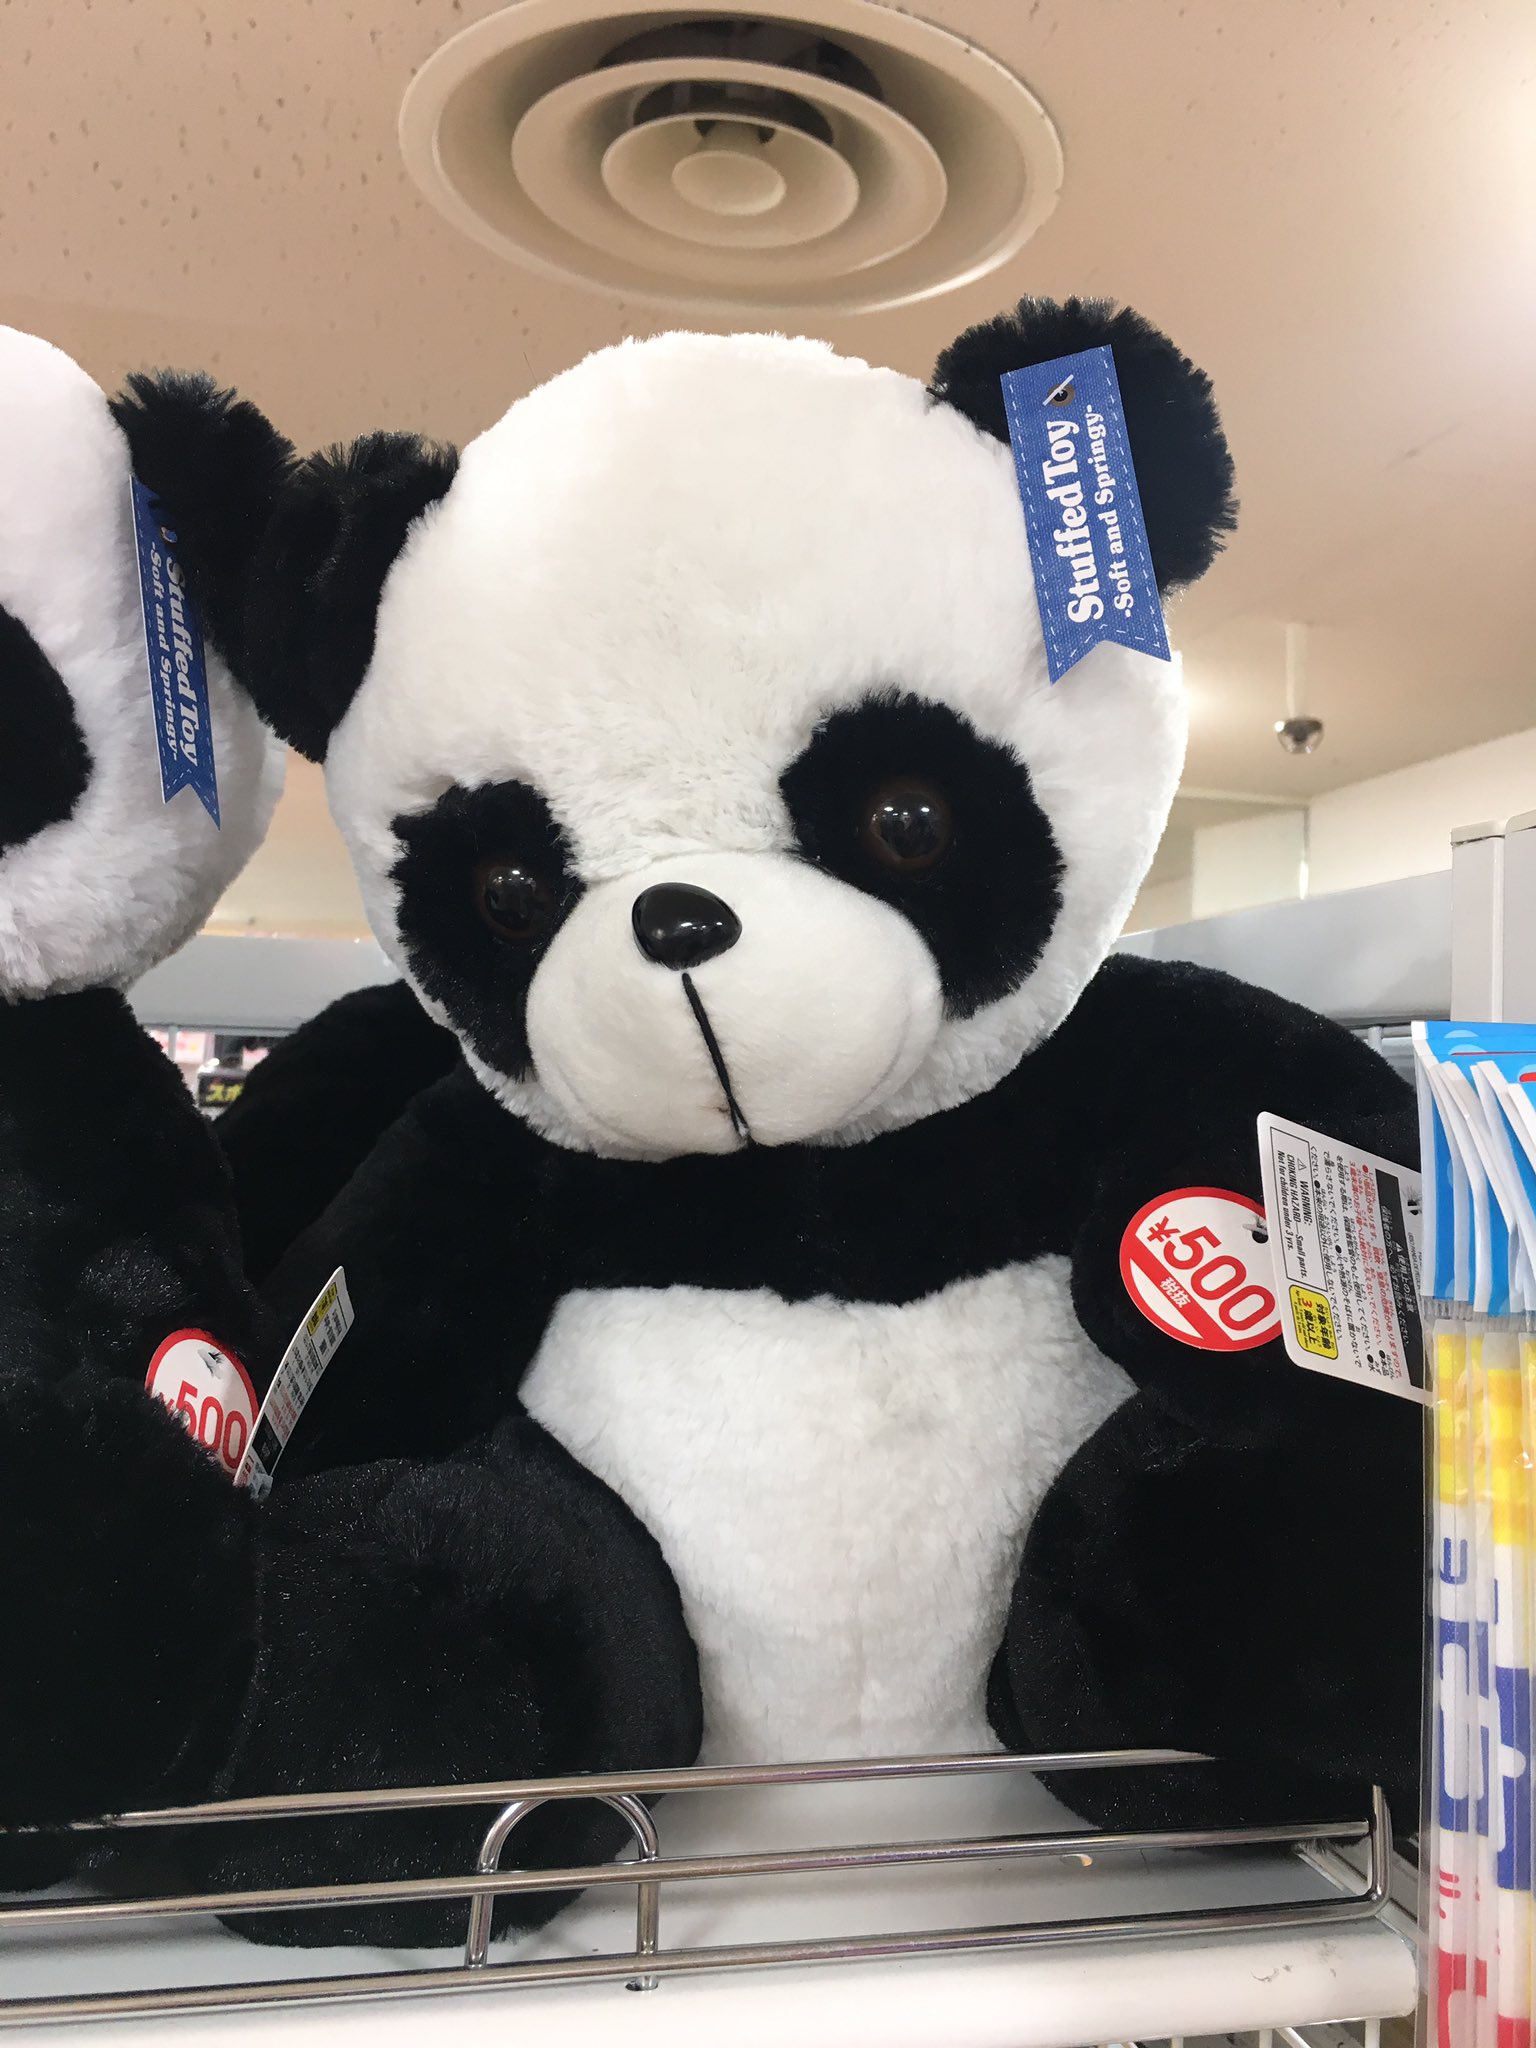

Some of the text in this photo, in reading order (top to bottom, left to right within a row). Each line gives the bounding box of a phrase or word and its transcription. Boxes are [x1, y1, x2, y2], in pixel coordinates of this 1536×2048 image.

[1042, 420, 1104, 623] Stuffed Toy
[1085, 404, 1134, 619] -Soft and Springy-
[155, 603, 171, 652] and
[166, 556, 200, 767] Stuffed Toy
[160, 655, 177, 762] Springy-
[1276, 1149, 1285, 1162] Not
[1278, 1161, 1286, 1176] for
[1279, 1175, 1290, 1208] children
[1299, 1179, 1312, 1226] WARNING:
[1282, 1206, 1292, 1230] under
[1286, 1153, 1297, 1189] CHOKING
[1297, 1256, 1307, 1279] parts.
[1285, 1235, 1294, 1252] yrs.
[1146, 1215, 1276, 1331] ¥500
[1160, 1276, 1191, 1309] 税抜
